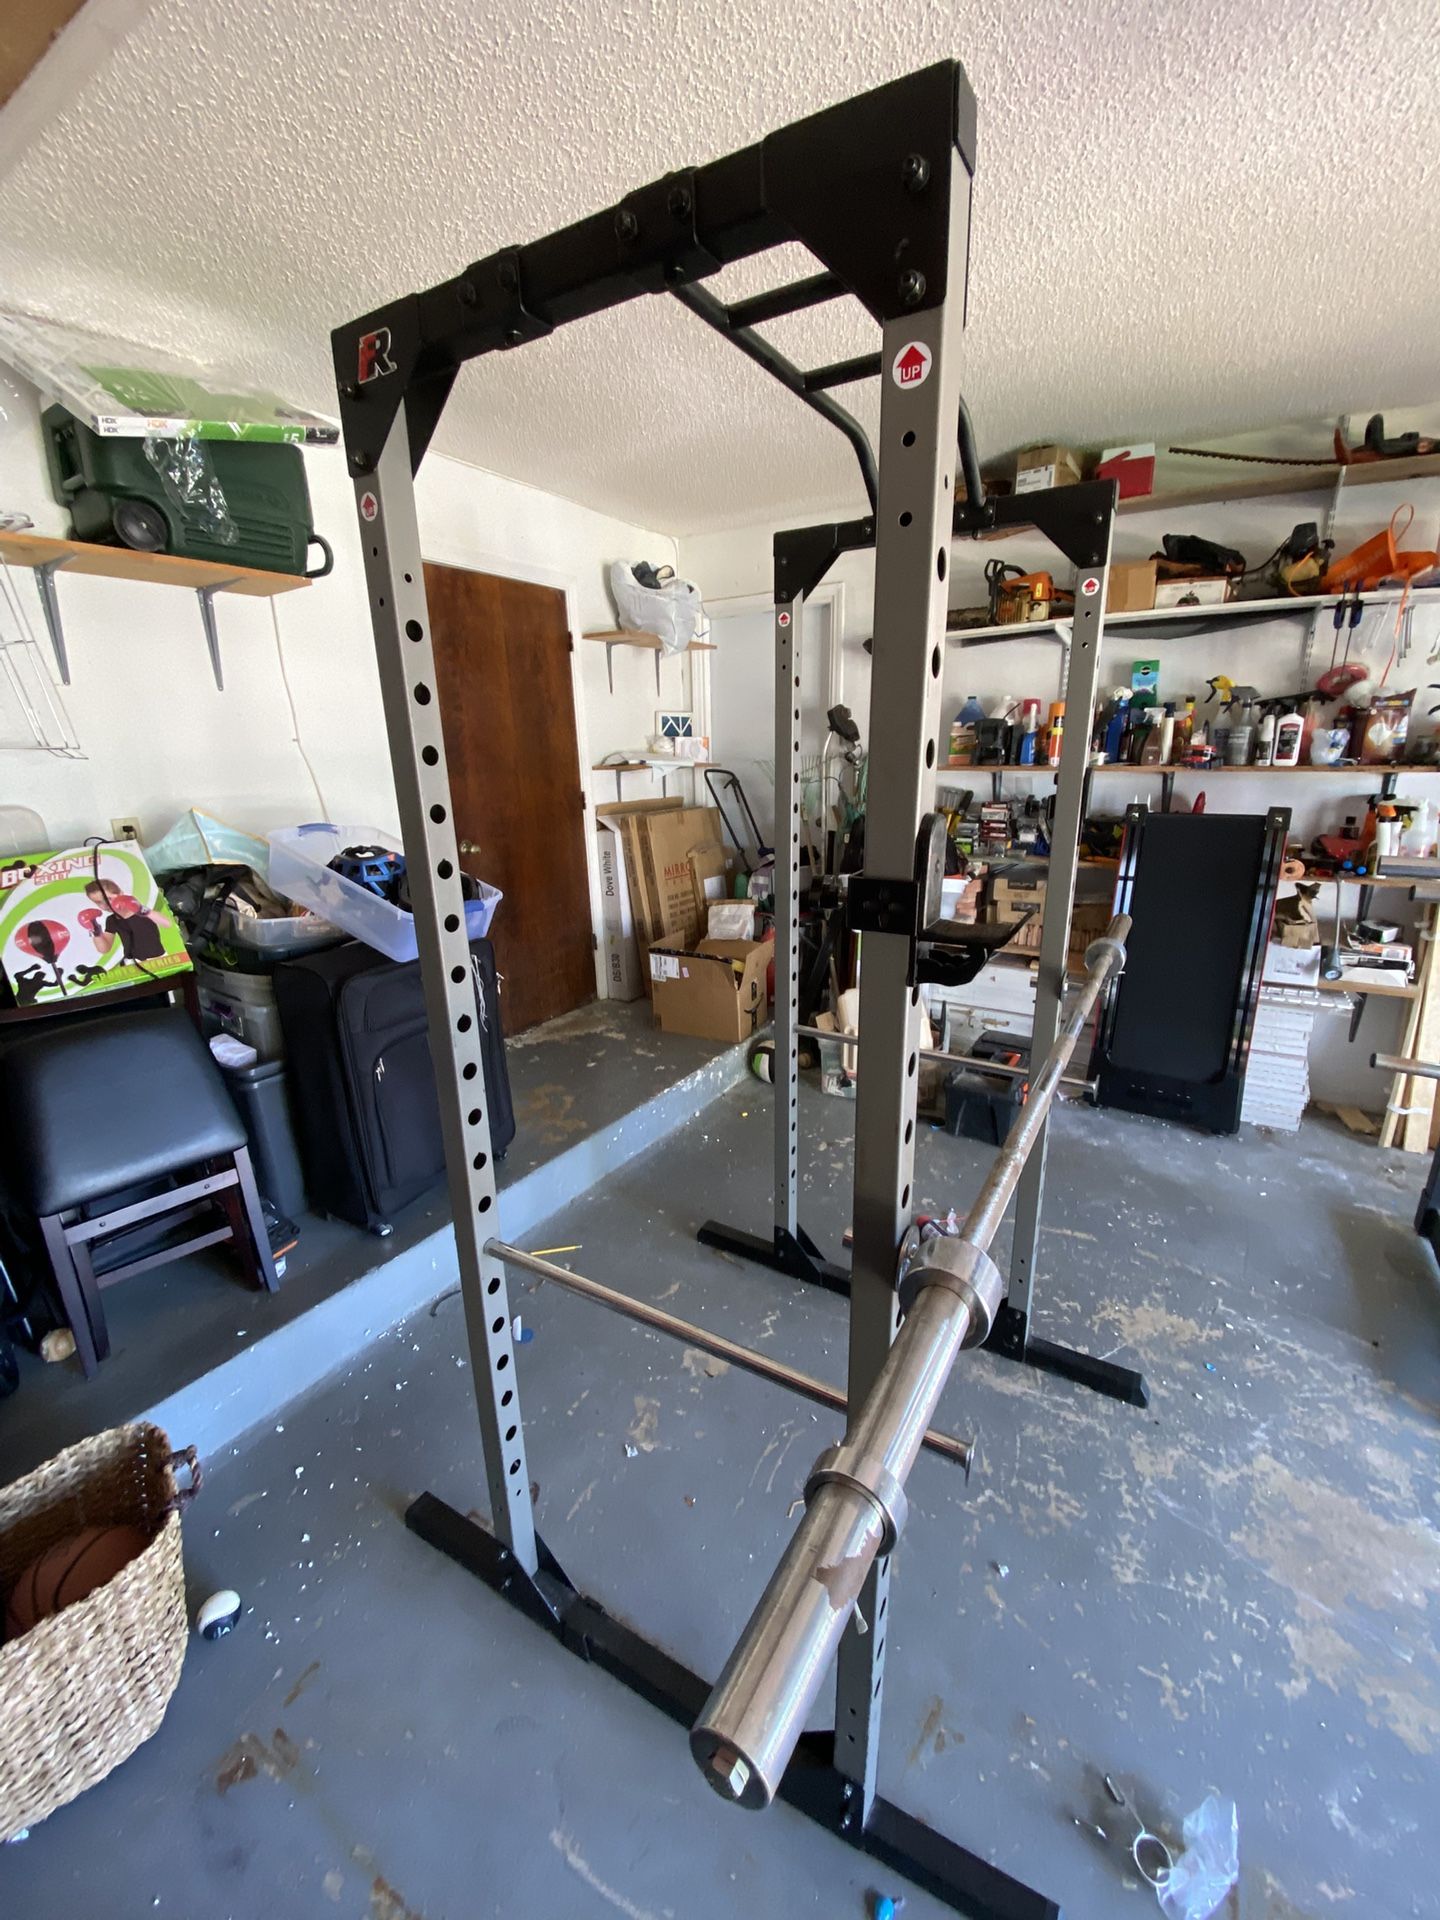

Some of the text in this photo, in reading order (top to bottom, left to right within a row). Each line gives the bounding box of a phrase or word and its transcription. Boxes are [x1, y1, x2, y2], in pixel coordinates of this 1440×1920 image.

[902, 364, 921, 380] UP
[602, 851, 615, 896] Dove White
